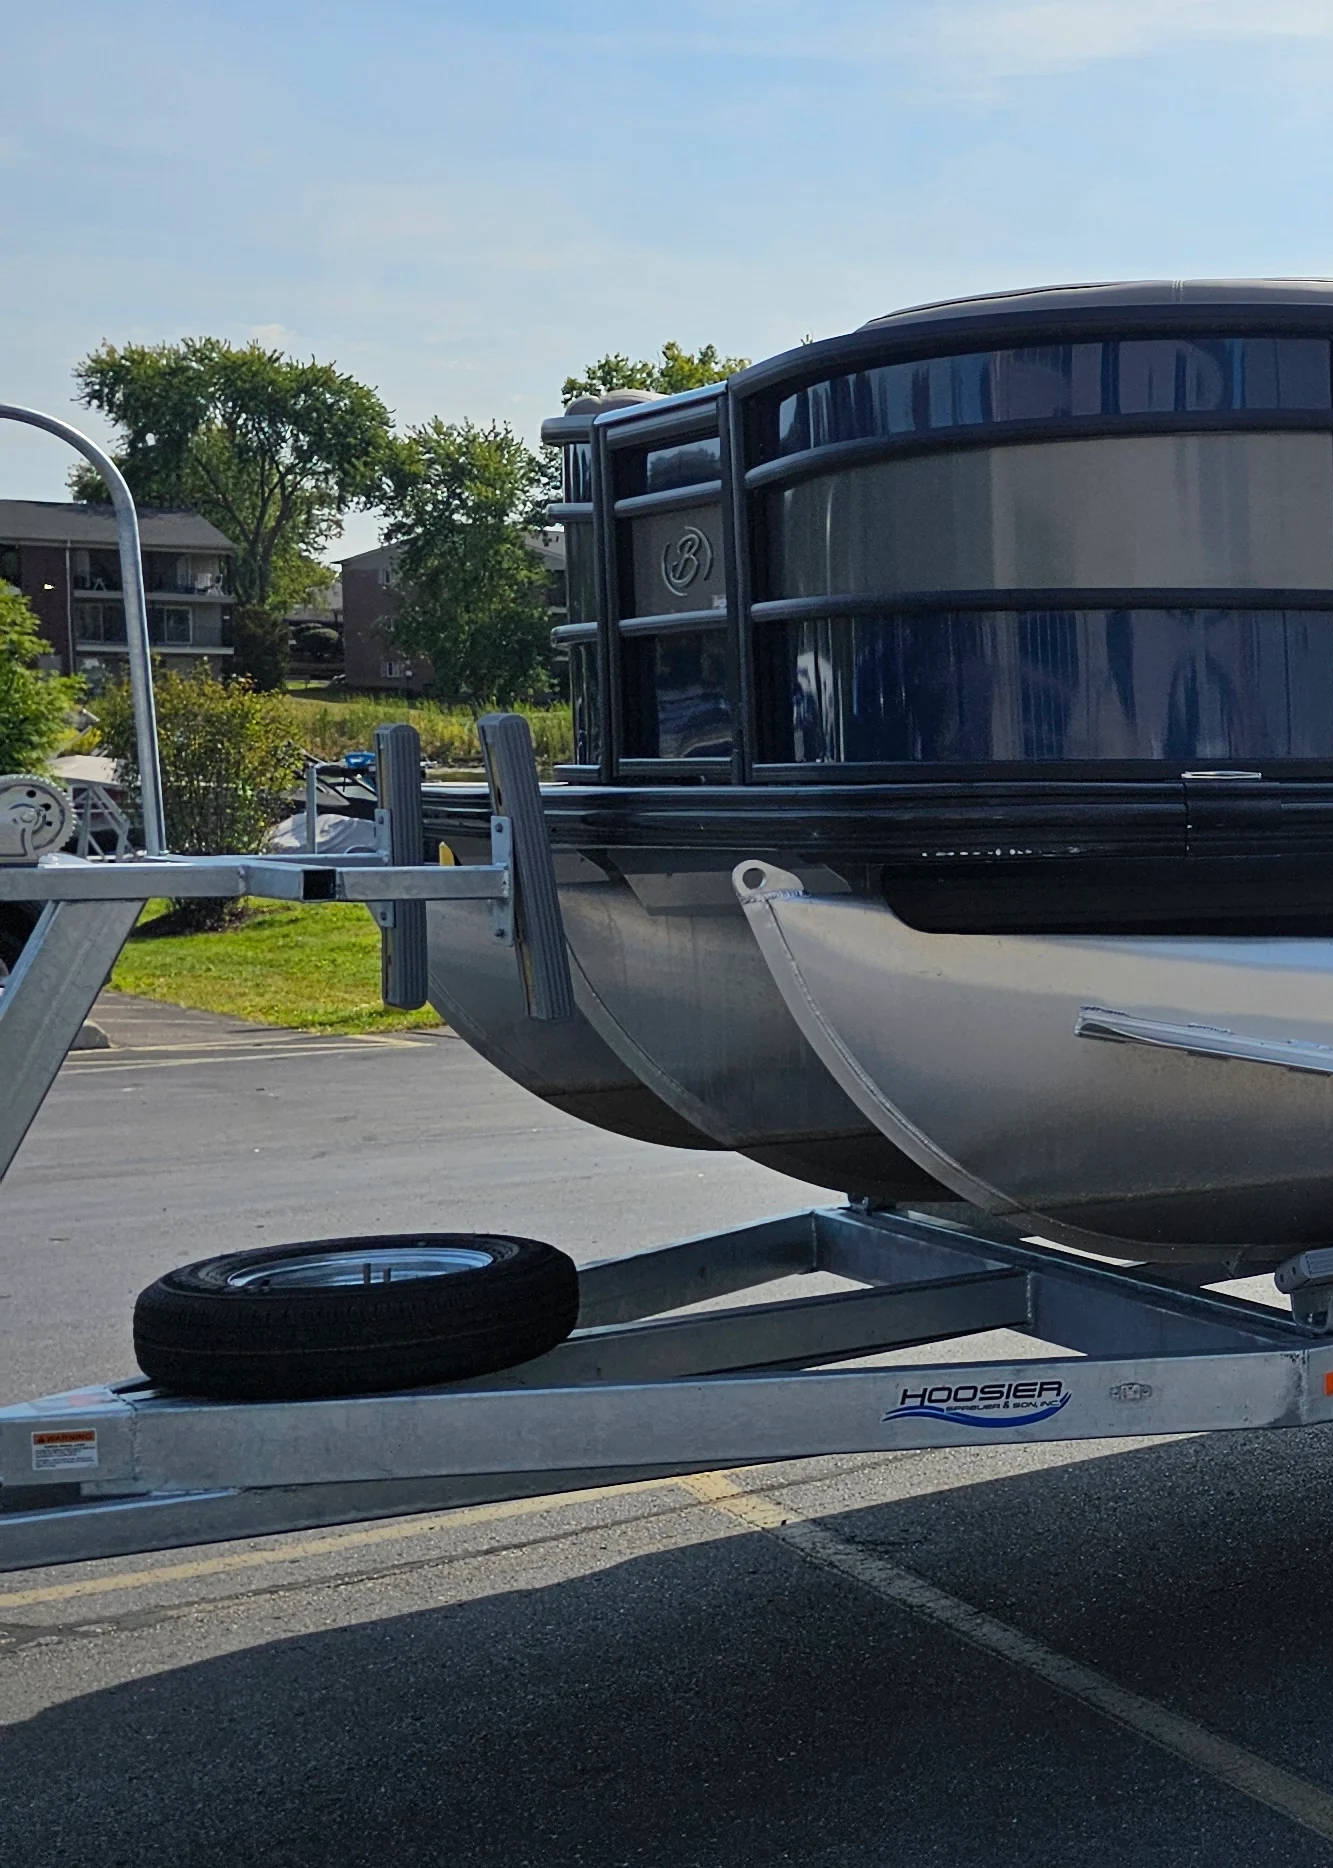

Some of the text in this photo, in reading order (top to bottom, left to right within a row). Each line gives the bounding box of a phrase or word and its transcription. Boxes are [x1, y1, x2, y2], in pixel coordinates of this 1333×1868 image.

[899, 1380, 1063, 1406] HOOSIER
[944, 1403, 1001, 1412] SPREUER
[1003, 1400, 1010, 1409] &
[1012, 1400, 1038, 1409] SON,
[47, 1430, 92, 1443] WARNING
